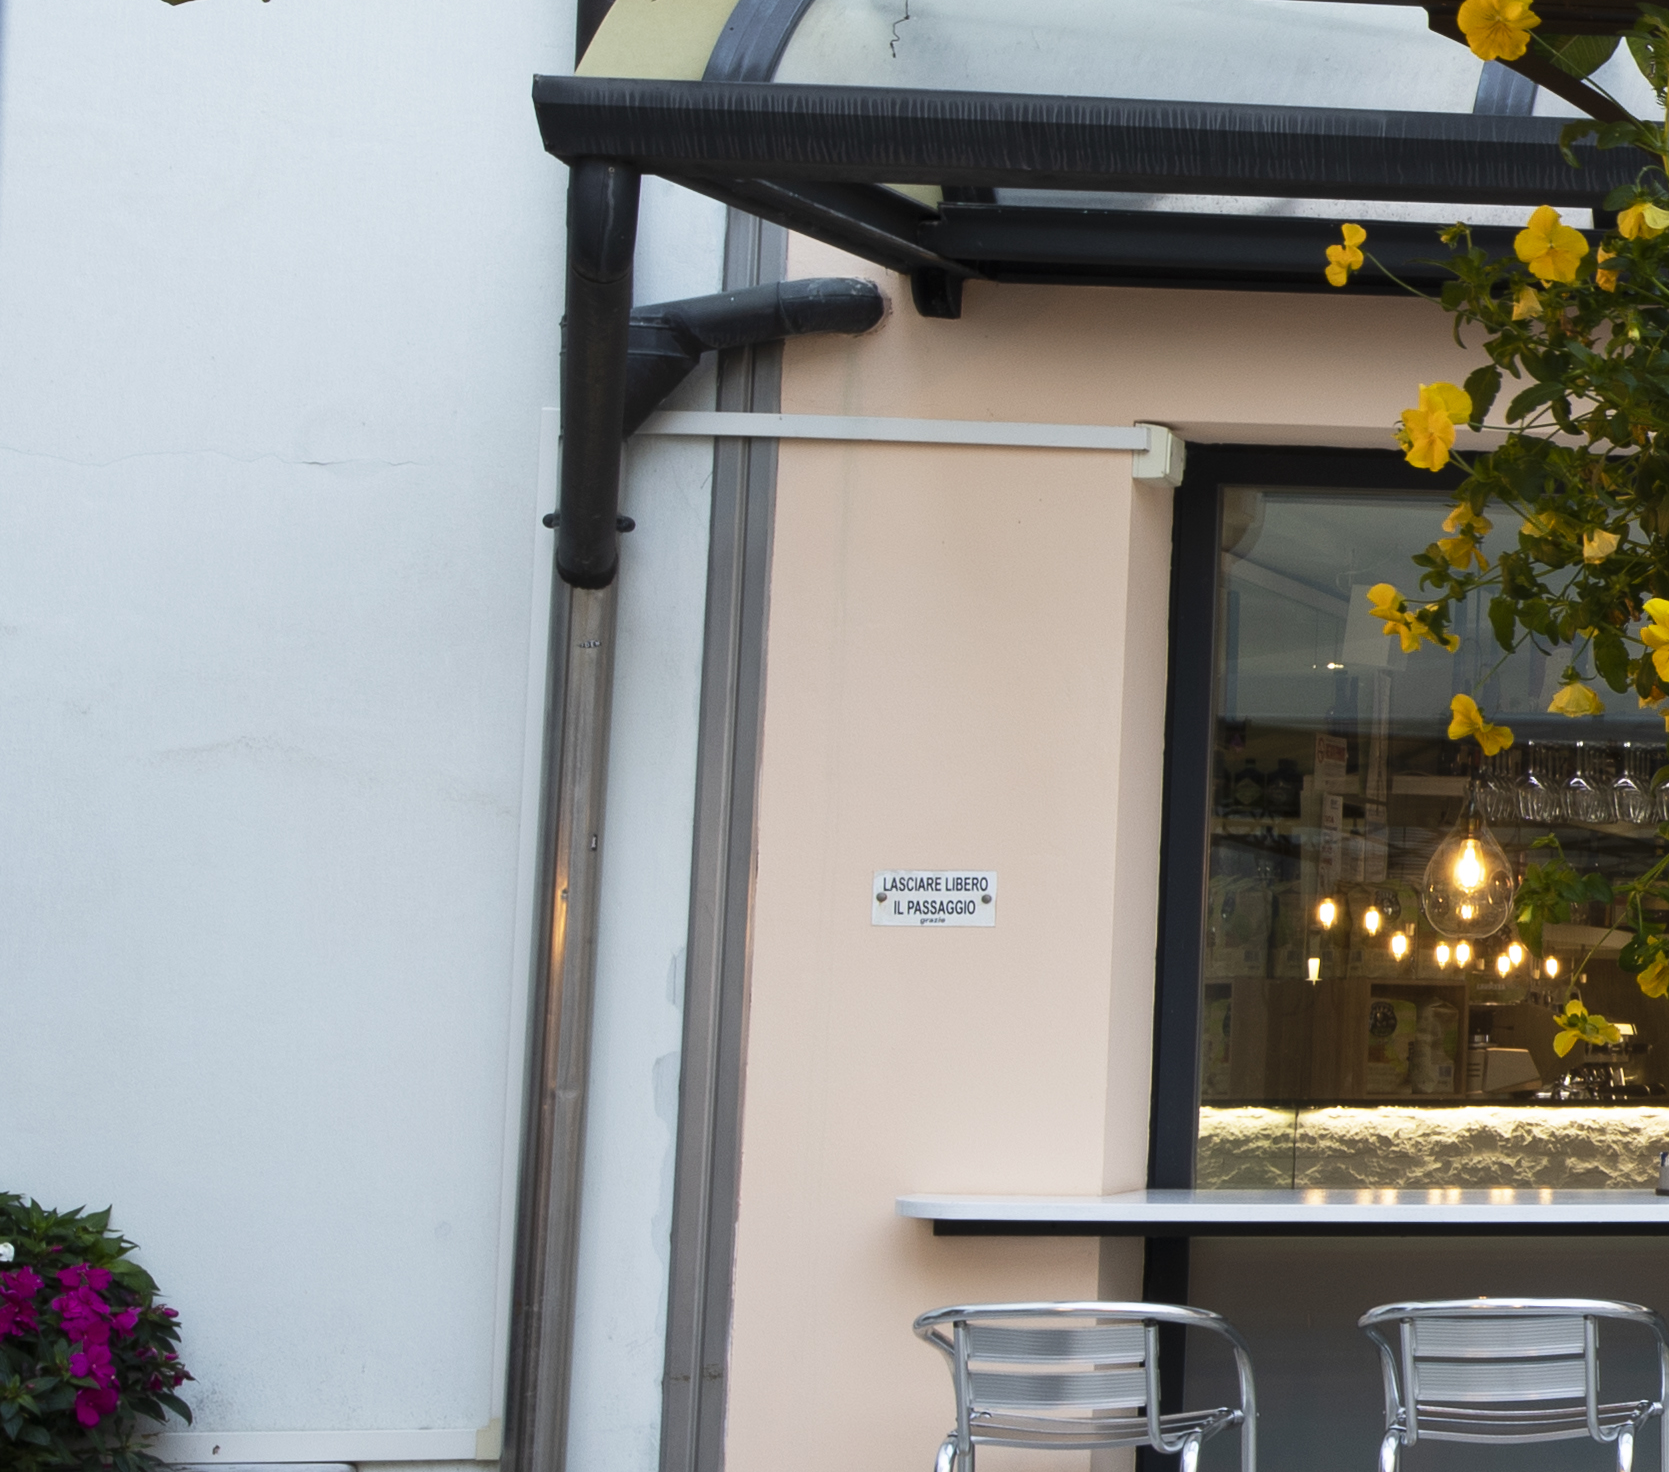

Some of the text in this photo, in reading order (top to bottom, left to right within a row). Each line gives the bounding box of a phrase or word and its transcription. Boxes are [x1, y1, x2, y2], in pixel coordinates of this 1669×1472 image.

[883, 876, 988, 892] LASCIARE LIBERO
[894, 900, 976, 916] IL PASSAGGIO
[920, 916, 946, 925] grazie
